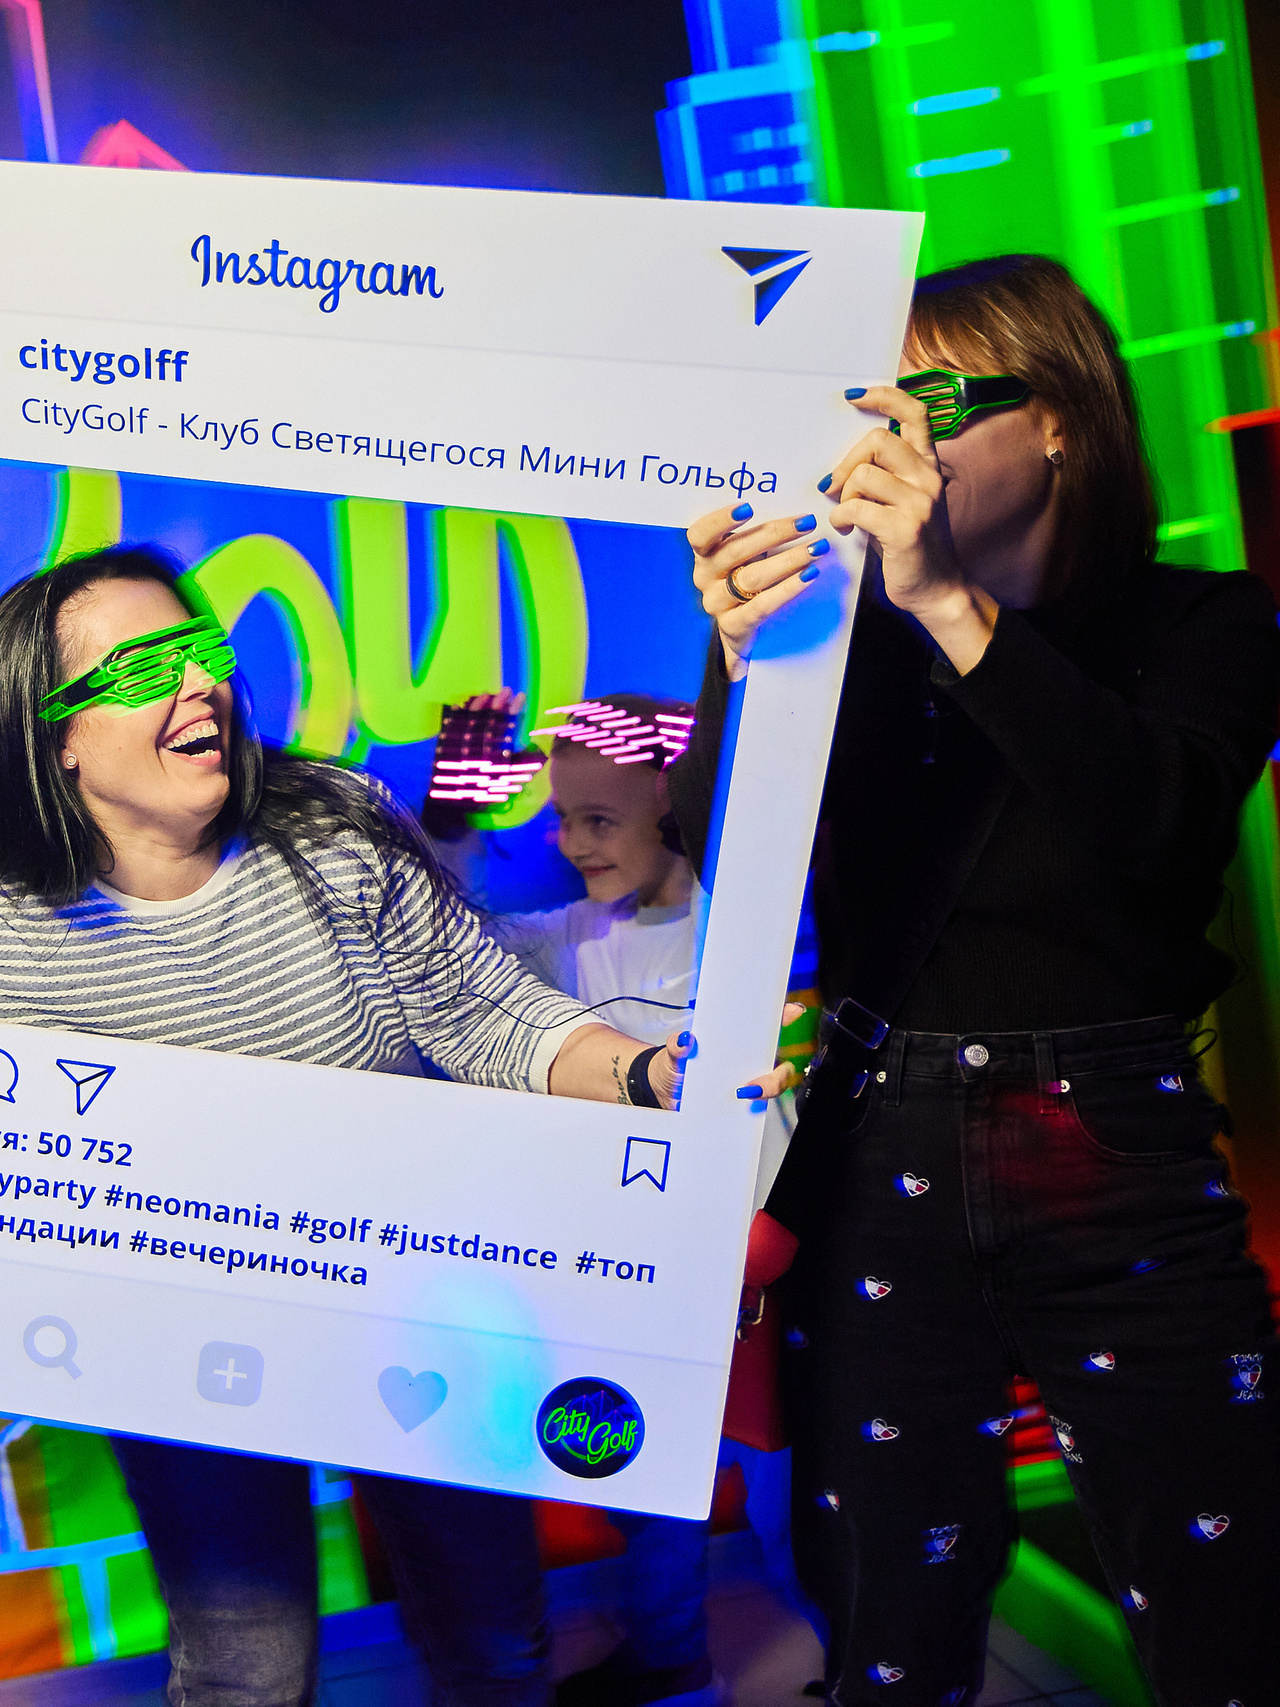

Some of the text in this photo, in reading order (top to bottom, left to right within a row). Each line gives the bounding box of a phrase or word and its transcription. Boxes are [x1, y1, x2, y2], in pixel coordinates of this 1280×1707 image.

[191, 234, 445, 314] Instagram
[19, 338, 190, 385] citygolff
[21, 398, 151, 435] CityGolf
[180, 411, 259, 451] Клуб
[271, 422, 506, 470] Светящегося
[519, 445, 626, 480] Мини
[640, 454, 778, 499] Гольфа
[37, 1131, 72, 1158] 50
[81, 1137, 133, 1167] 752
[104, 1183, 280, 1231] #neomania
[289, 1210, 372, 1244] #golf
[378, 1223, 558, 1270] #justdance
[575, 1250, 656, 1284] #топ
[128, 1229, 368, 1286] #вечериночка
[543, 1407, 591, 1443] City
[587, 1420, 638, 1464] Golf
